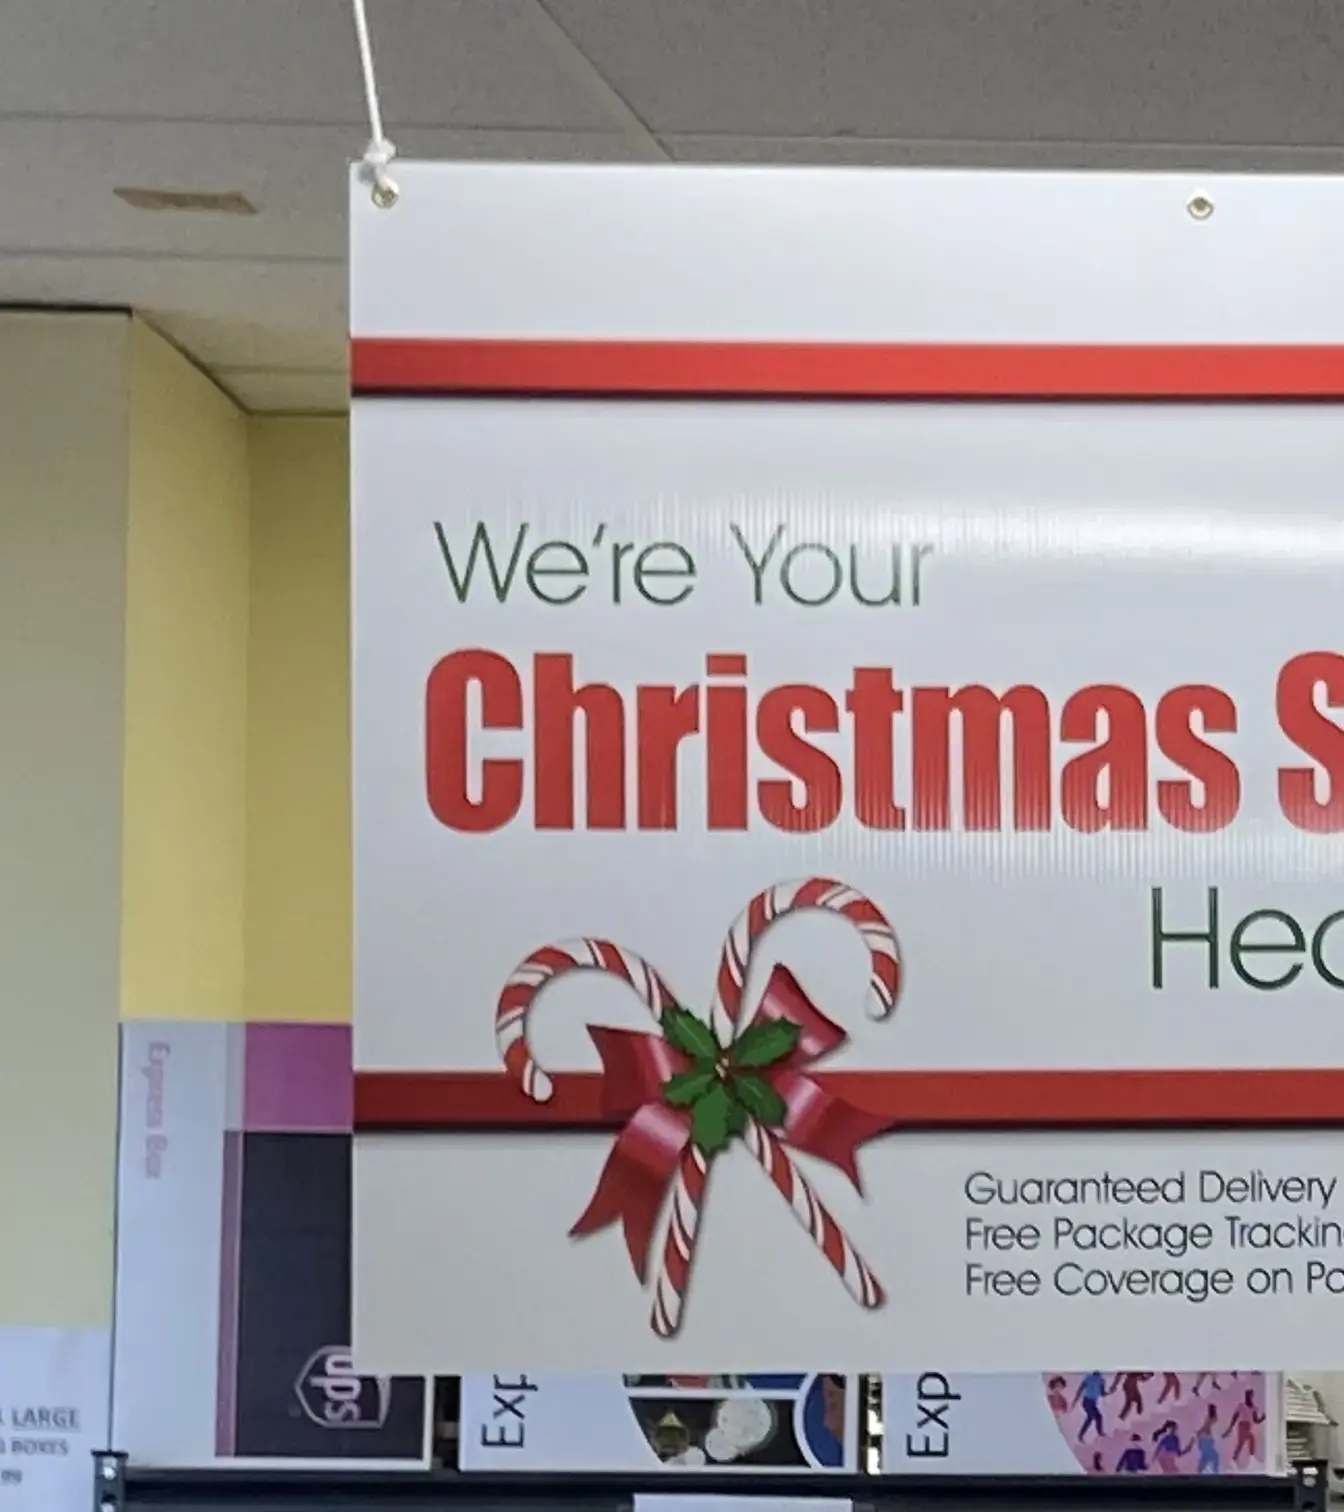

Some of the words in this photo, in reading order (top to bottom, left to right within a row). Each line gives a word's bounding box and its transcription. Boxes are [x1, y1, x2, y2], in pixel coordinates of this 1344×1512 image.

[433, 521, 697, 606] We're
[730, 522, 935, 607] Your
[424, 648, 1239, 834] Christmas
[964, 1170, 1185, 1205] Guaranteed
[1200, 1169, 1337, 1208] Delivery
[965, 1218, 1041, 1251] Free
[1054, 1217, 1213, 1257] Package
[965, 1263, 1041, 1297] Free
[1053, 1262, 1234, 1303] Coverage
[1246, 1267, 1294, 1295] on
[907, 1371, 962, 1458] Exp
